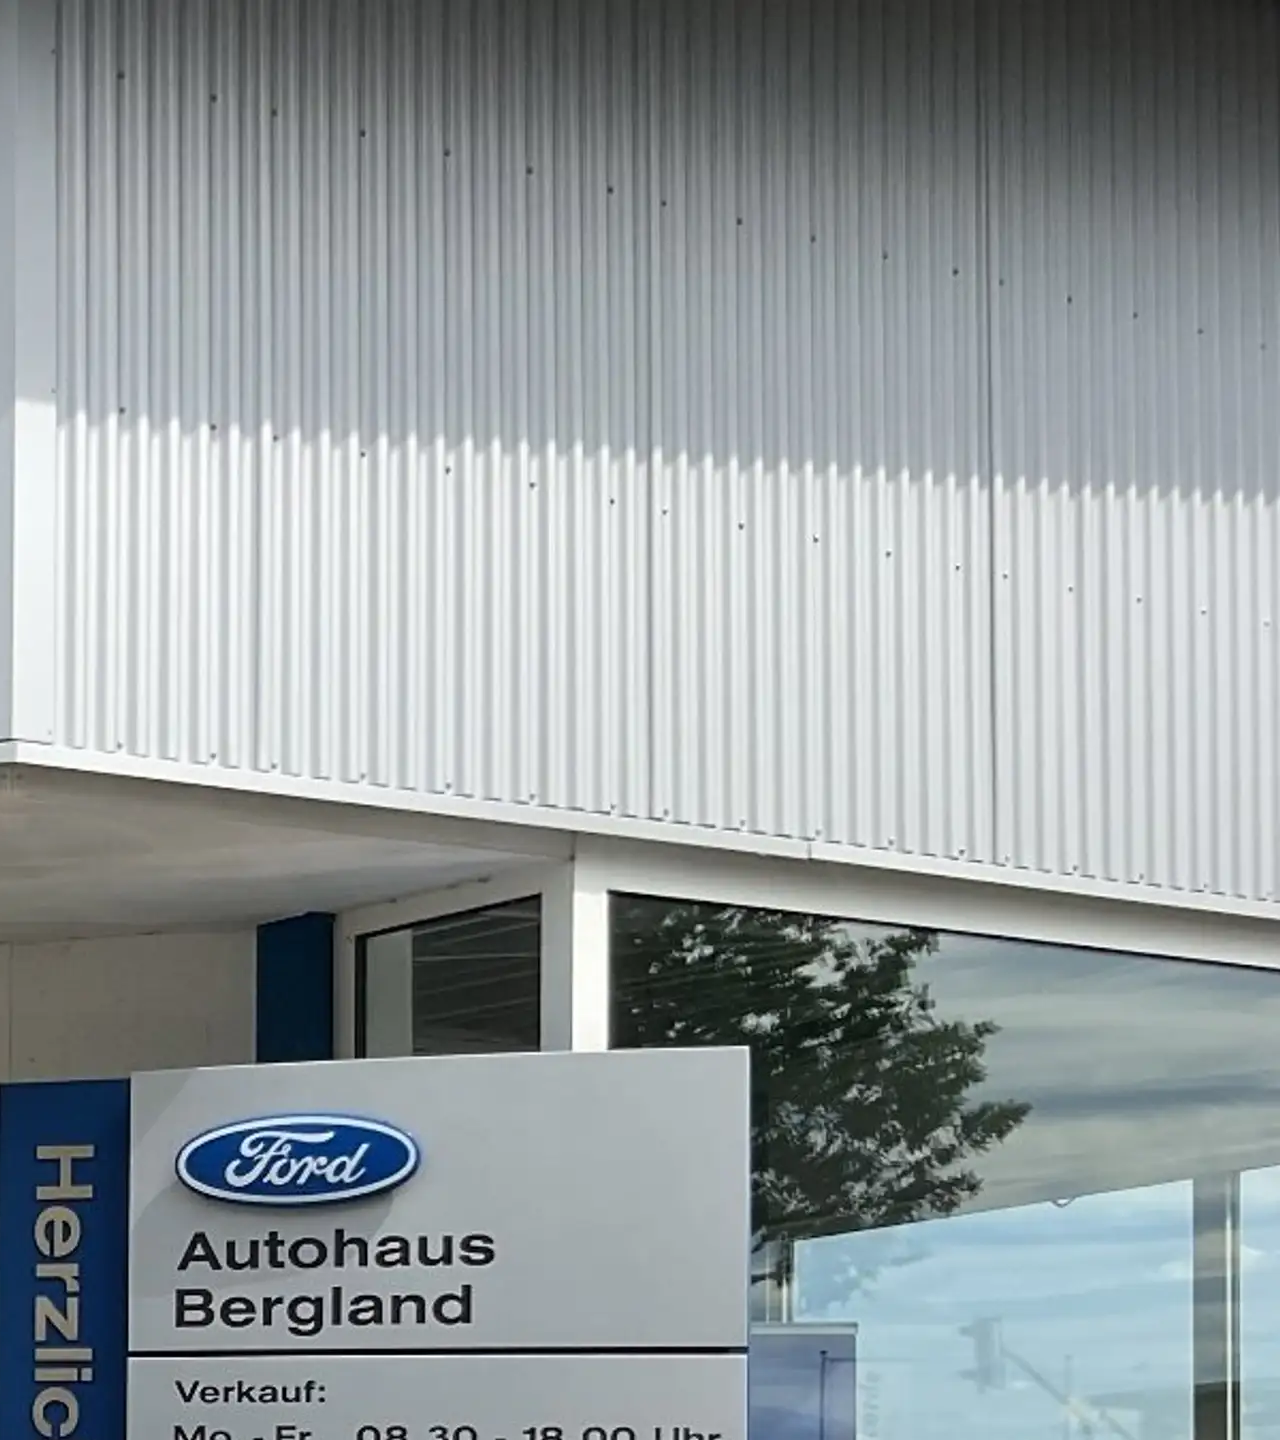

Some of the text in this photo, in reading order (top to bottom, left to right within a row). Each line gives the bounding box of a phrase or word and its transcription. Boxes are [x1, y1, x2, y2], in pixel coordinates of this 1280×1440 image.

[225, 1130, 371, 1188] Ford
[177, 1228, 496, 1271] Autohaus
[174, 1284, 473, 1337] Bergland
[175, 1380, 327, 1404] Verkauf:
